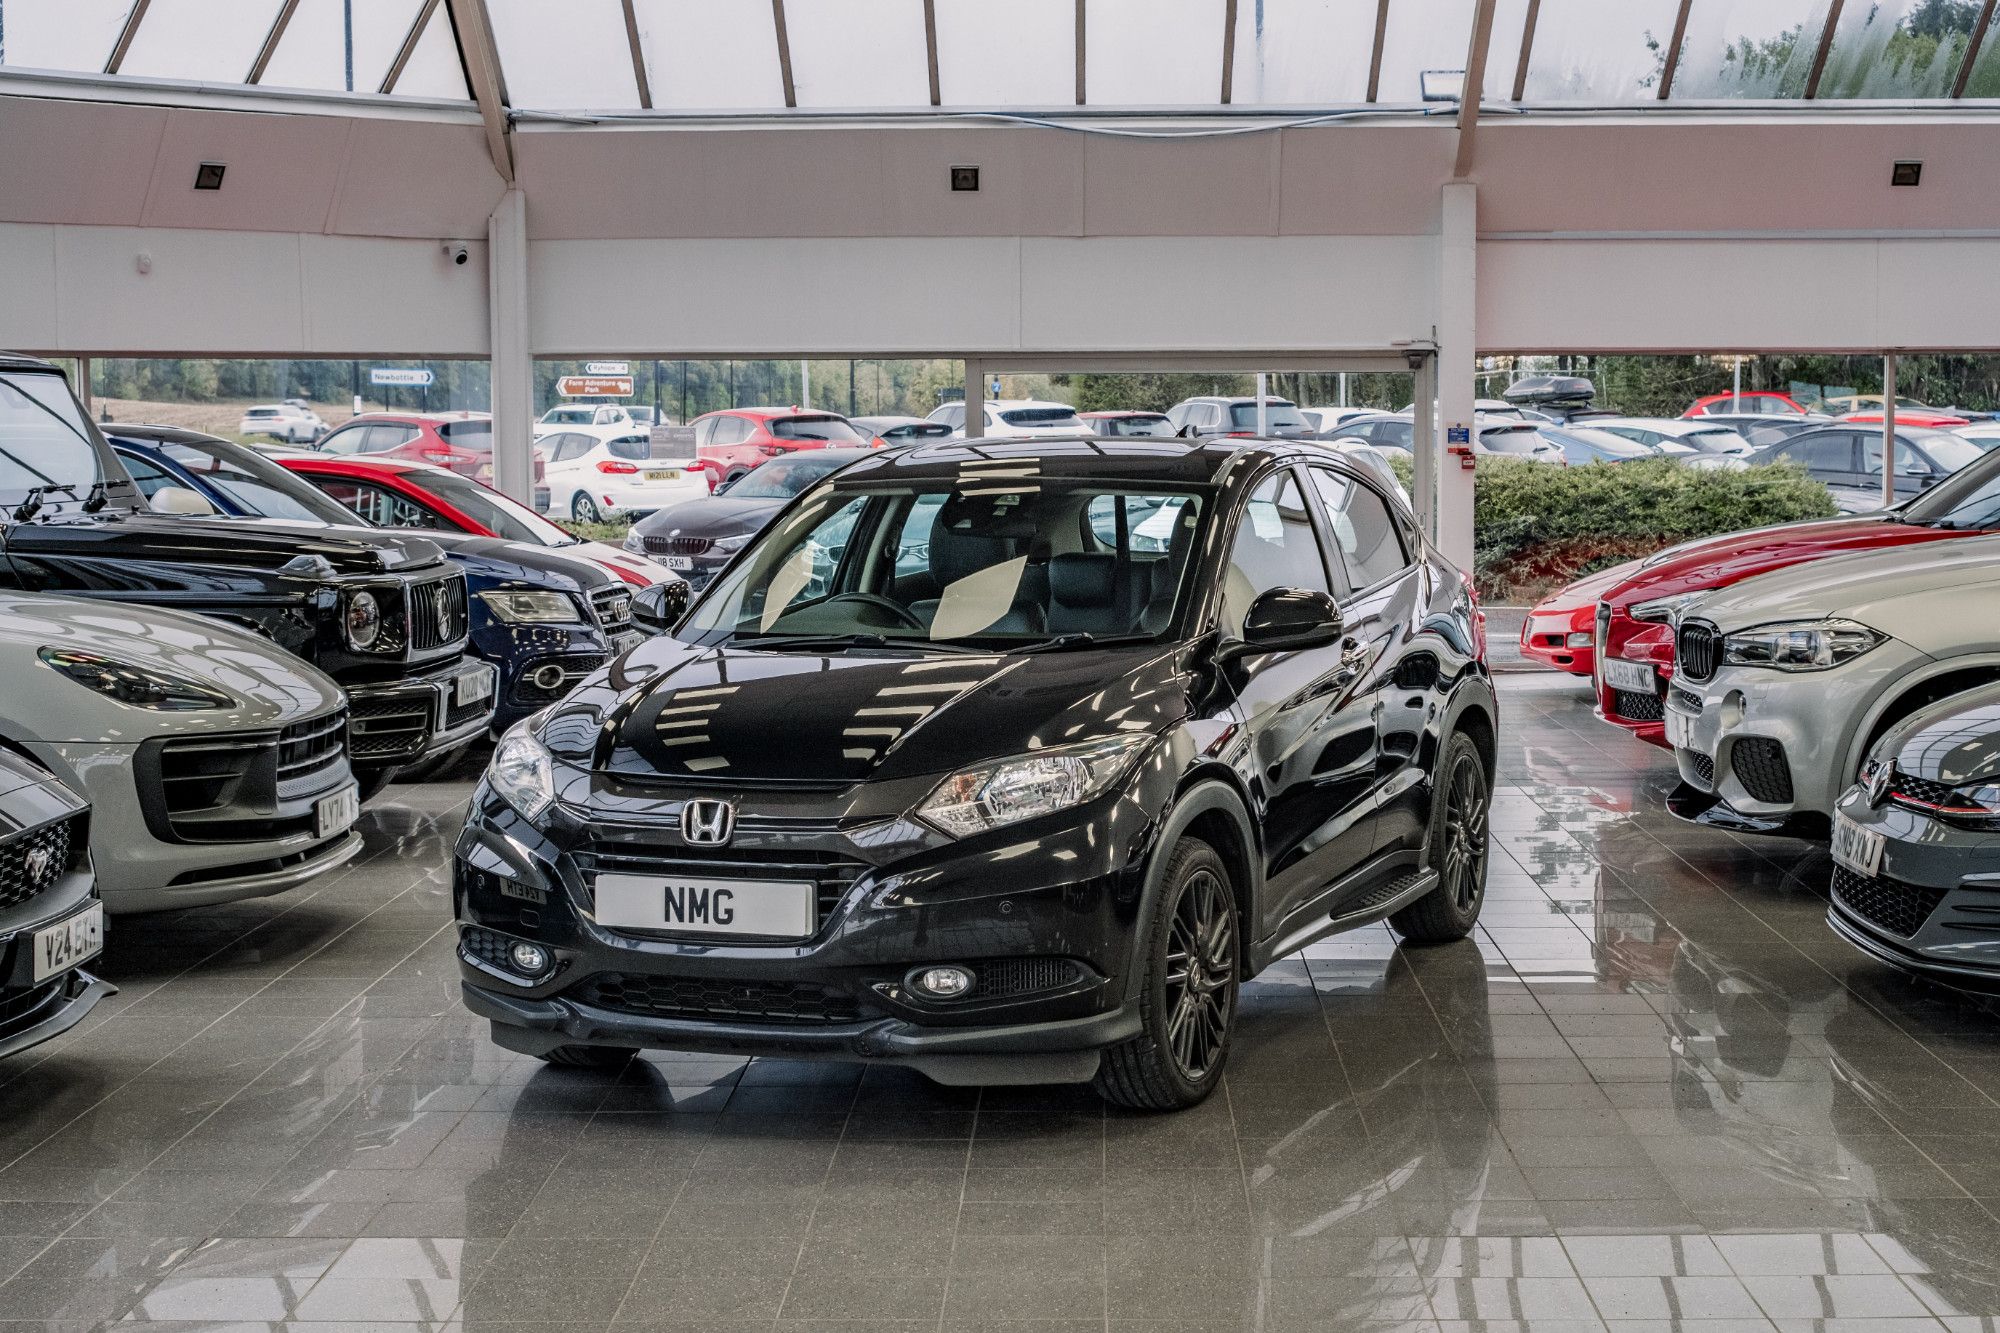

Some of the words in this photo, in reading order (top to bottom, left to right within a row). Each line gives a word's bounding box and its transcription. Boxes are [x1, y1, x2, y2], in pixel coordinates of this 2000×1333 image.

[375, 373, 414, 381] Newbottle
[568, 379, 584, 387] Farm
[585, 379, 616, 387] Adventure
[668, 557, 685, 568] SXH
[1606, 661, 1630, 684] LX68
[1631, 665, 1650, 689] HNC
[322, 797, 344, 830] LY74
[664, 886, 734, 925] NMG
[46, 925, 71, 969] V24
